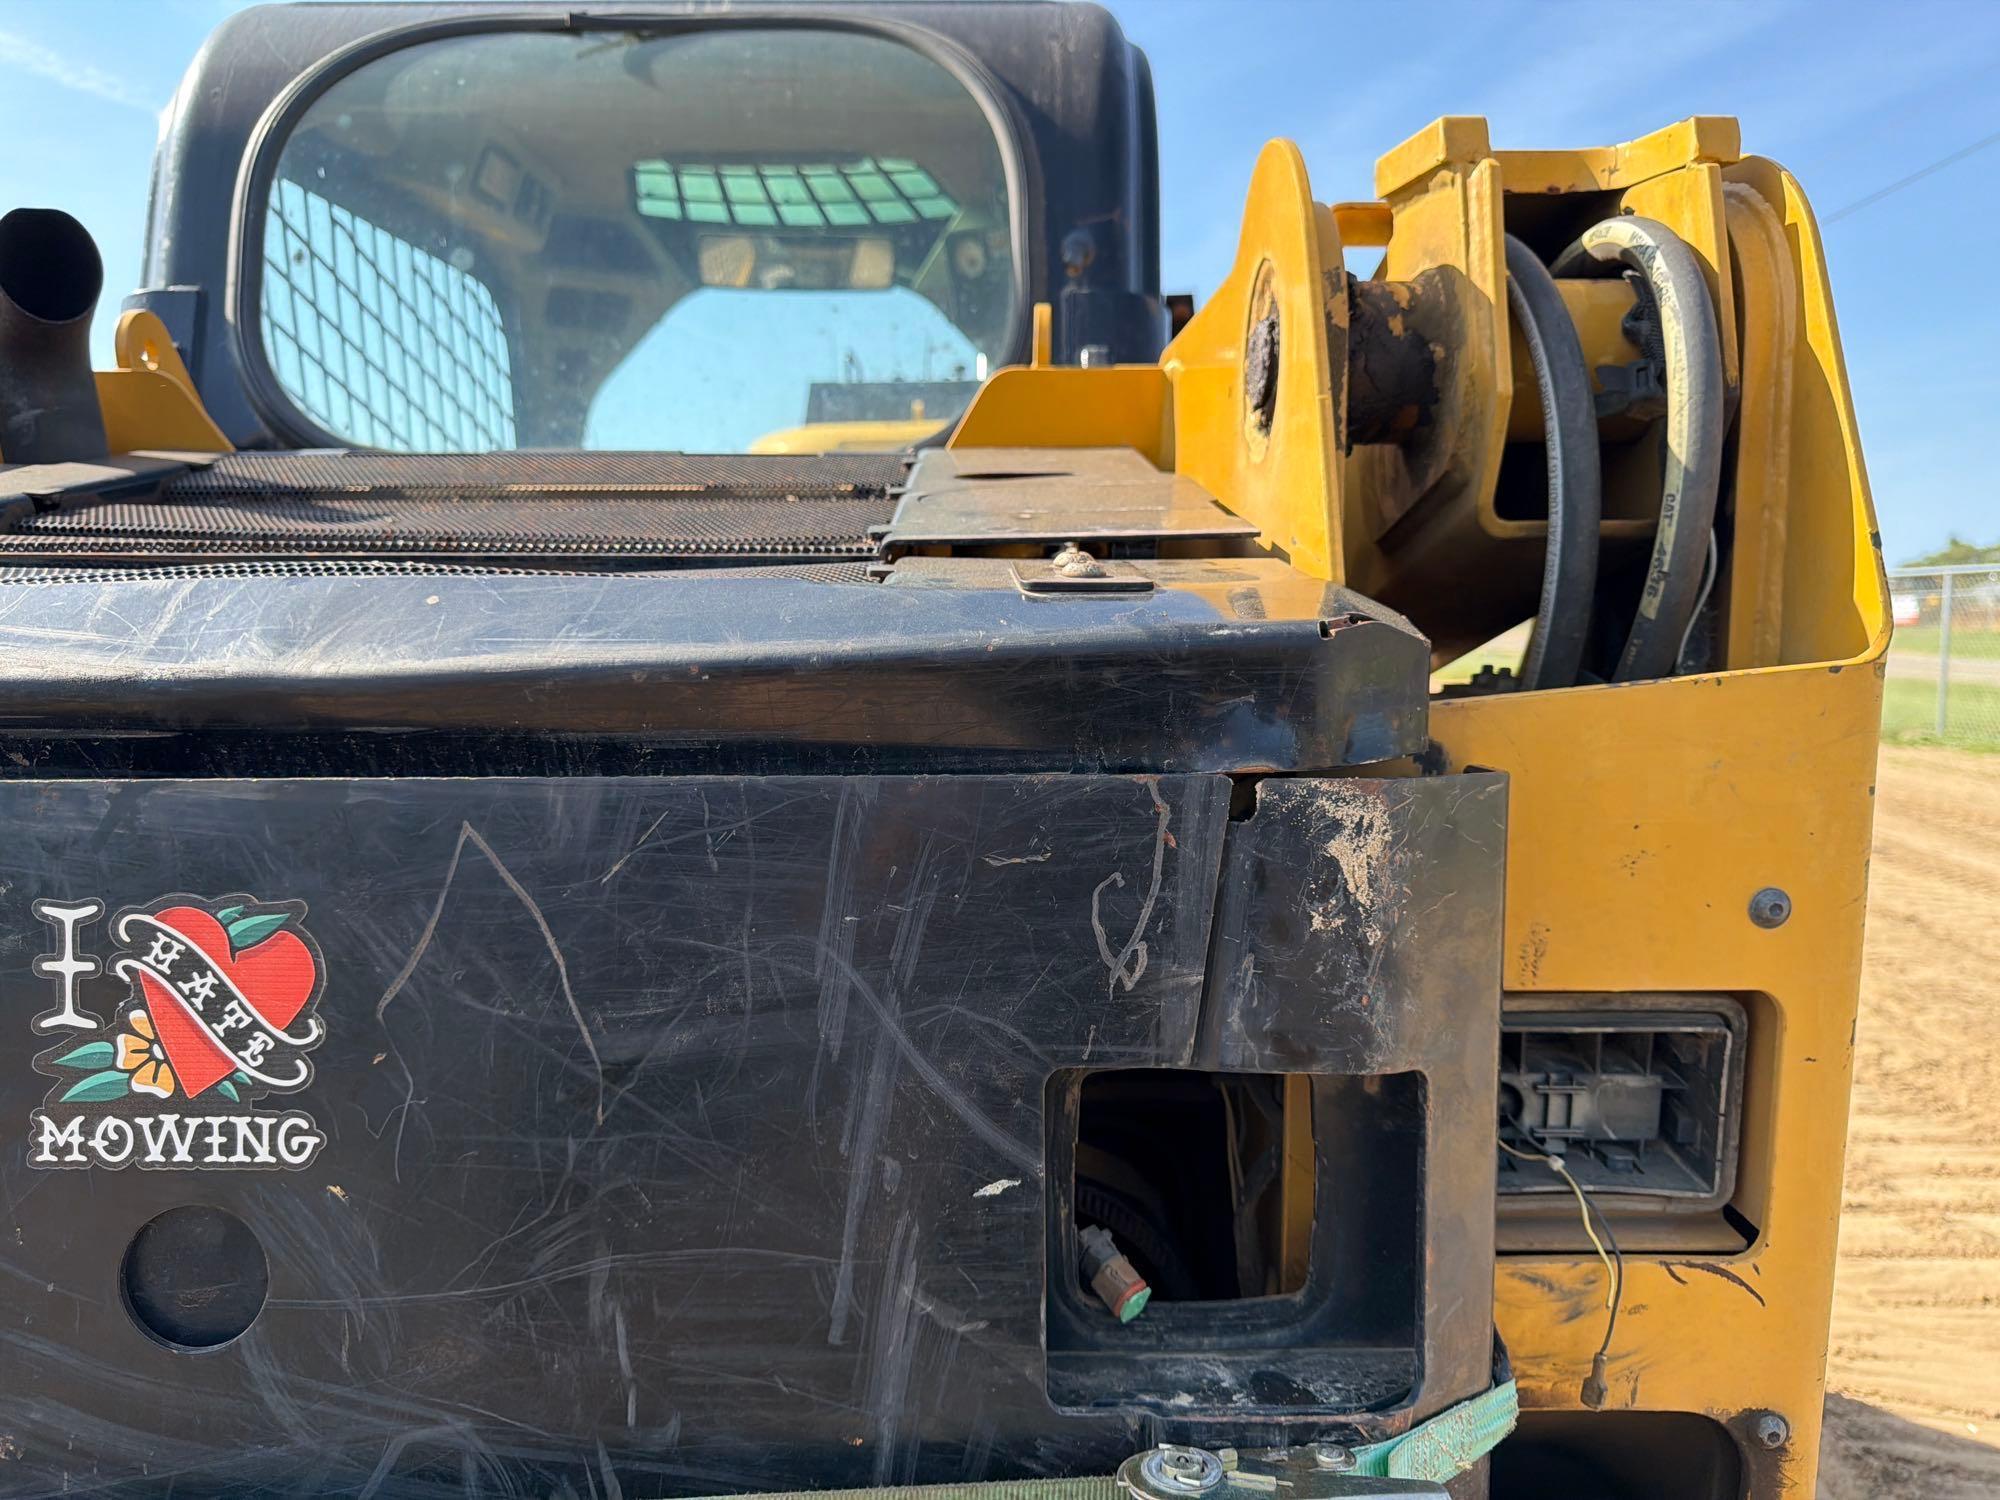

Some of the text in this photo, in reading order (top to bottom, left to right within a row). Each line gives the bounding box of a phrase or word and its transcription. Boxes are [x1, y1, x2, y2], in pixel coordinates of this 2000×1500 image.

[1663, 493, 1676, 526] CAT
[40, 905, 275, 1067] I HATE
[35, 1113, 320, 1164] MOWING
